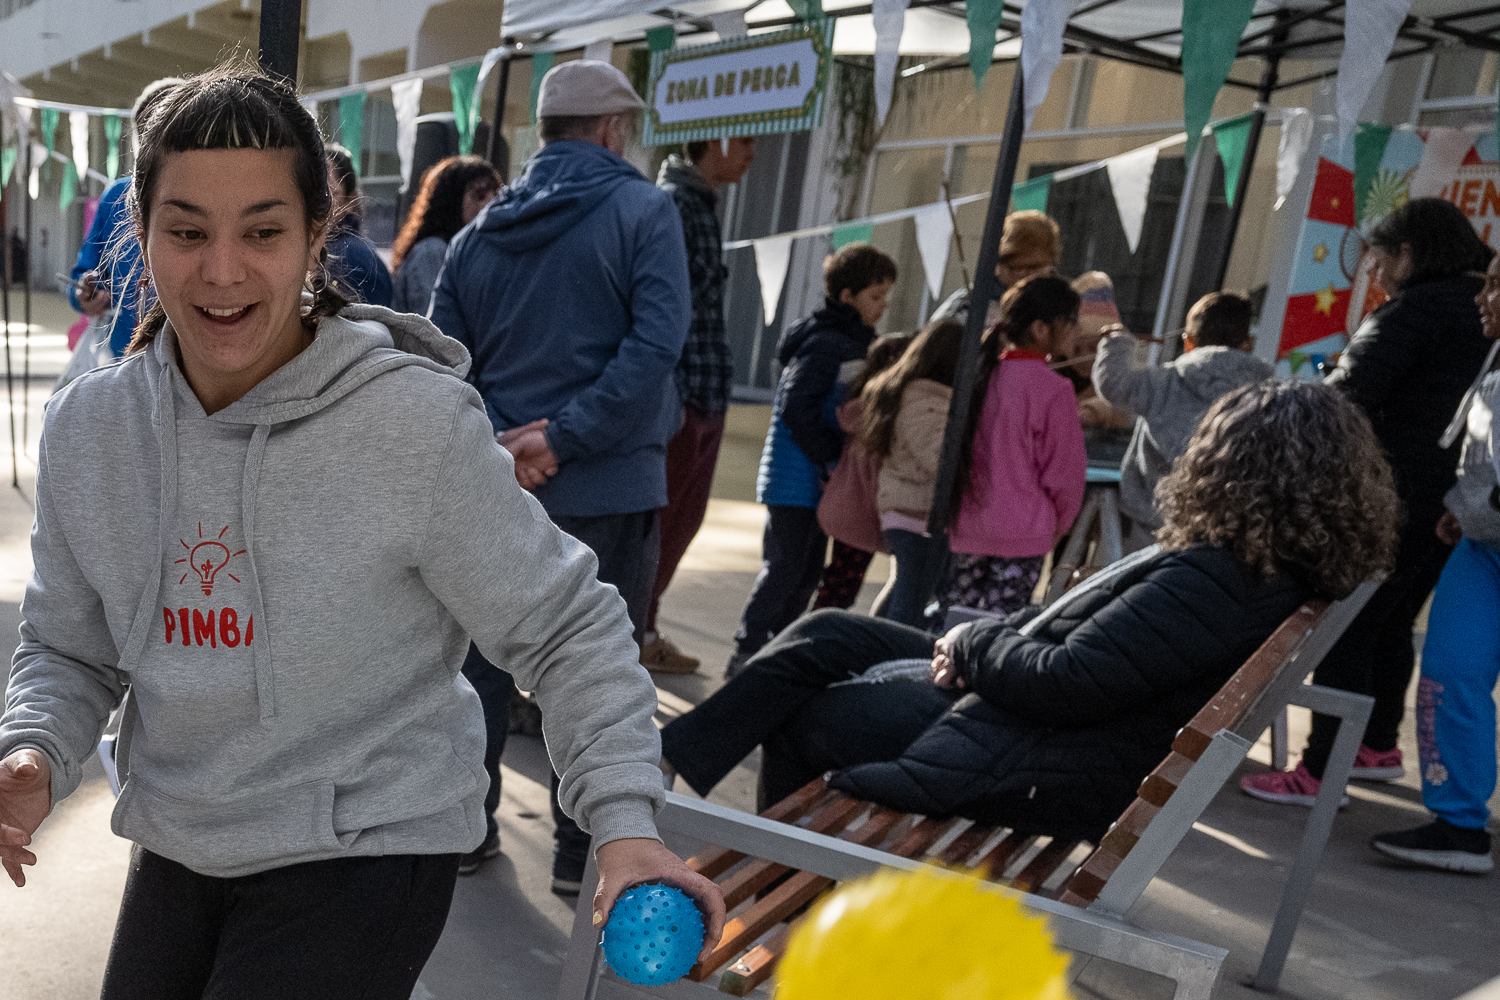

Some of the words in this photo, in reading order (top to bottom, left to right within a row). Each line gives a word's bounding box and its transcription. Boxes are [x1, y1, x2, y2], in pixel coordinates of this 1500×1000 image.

[665, 76, 708, 105] ZONA
[713, 71, 737, 98] DE
[739, 61, 800, 95] PESCA
